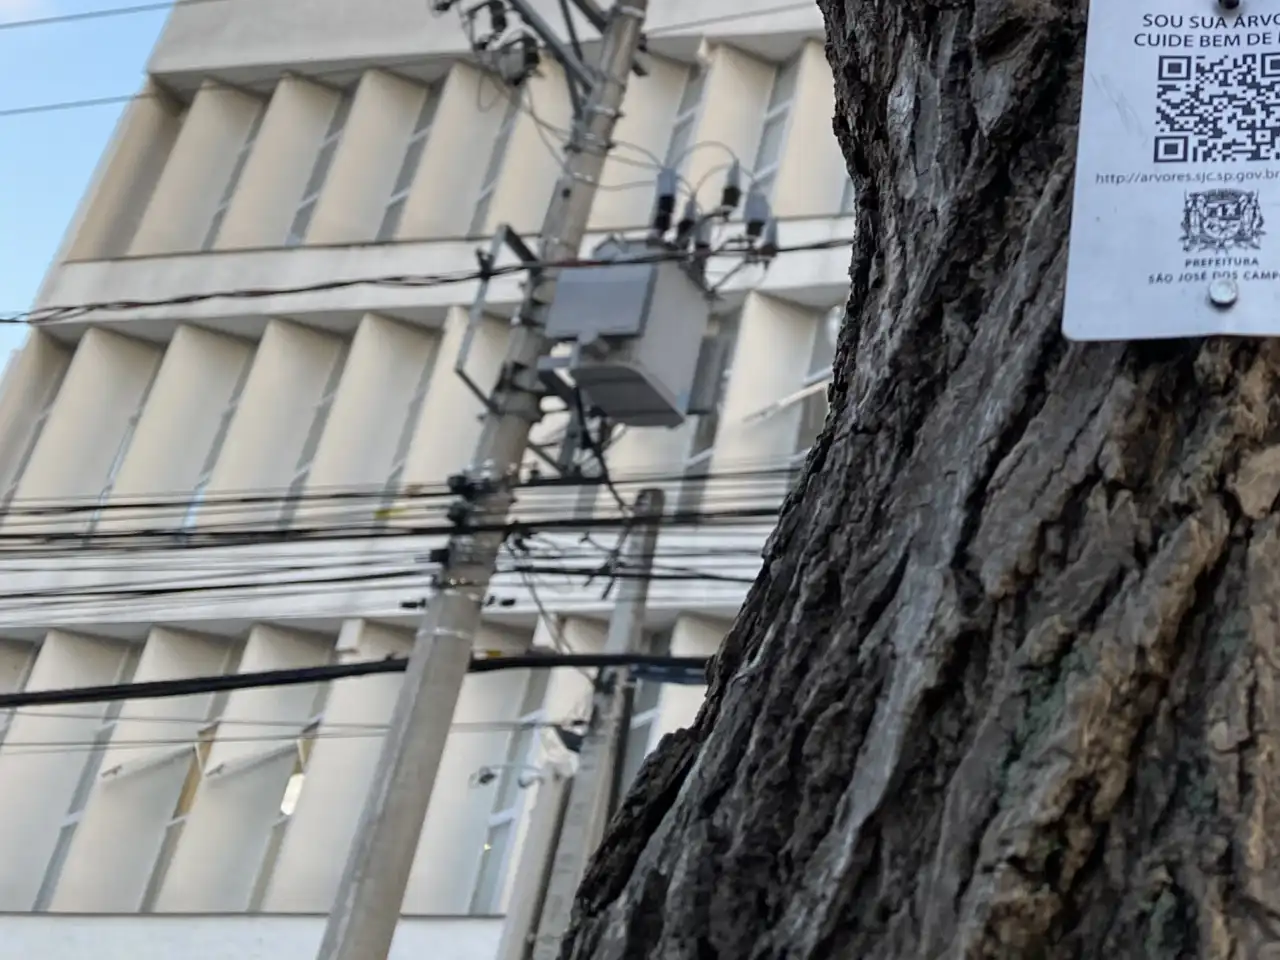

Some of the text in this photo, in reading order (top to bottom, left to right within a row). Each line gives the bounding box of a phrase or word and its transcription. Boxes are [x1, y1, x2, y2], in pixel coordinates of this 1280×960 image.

[1142, 14, 1183, 28] SOU
[1188, 15, 1228, 29] SUA
[1134, 33, 1194, 48] CUIDE
[1199, 33, 1240, 48] BEM
[1247, 31, 1272, 46] DE
[1184, 257, 1259, 268] PREFEITURA
[1148, 272, 1173, 285] SÃO
[1178, 270, 1207, 282] JOSÉ
